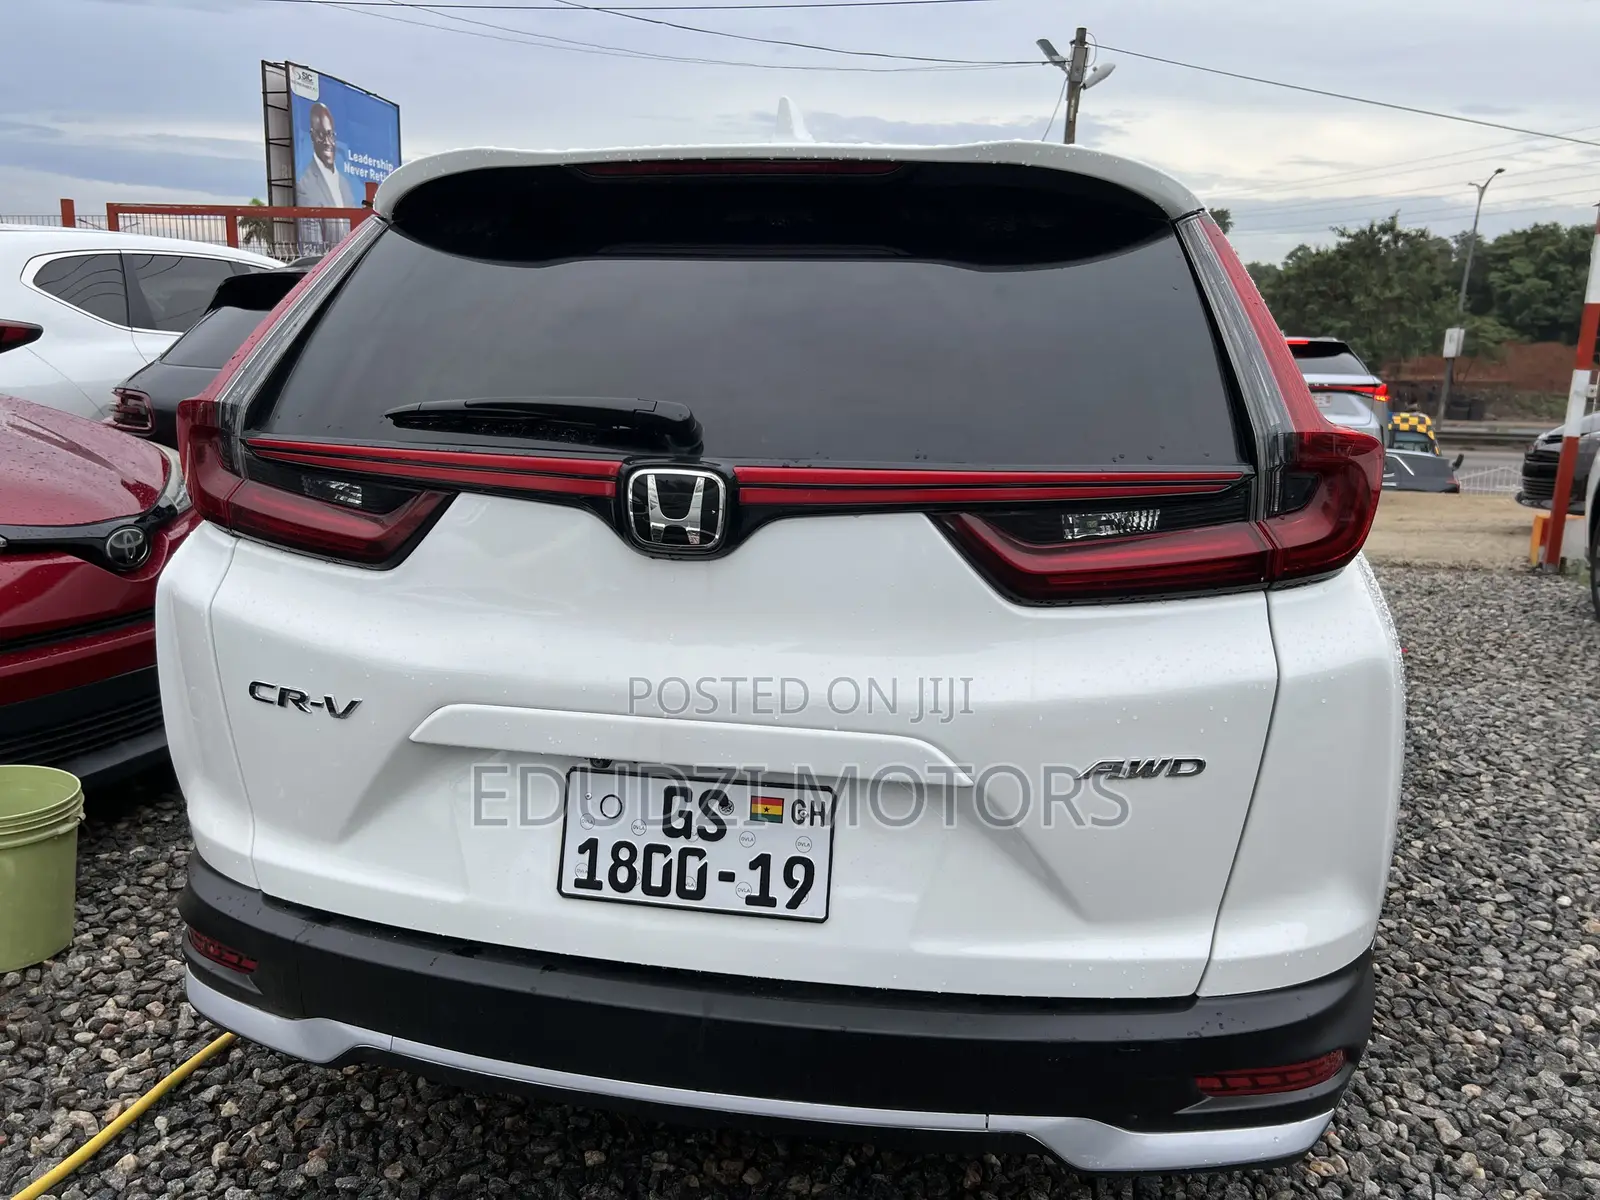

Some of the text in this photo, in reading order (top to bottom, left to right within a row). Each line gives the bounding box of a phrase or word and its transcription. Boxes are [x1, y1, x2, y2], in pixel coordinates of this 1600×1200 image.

[343, 161, 368, 178] Never
[348, 149, 394, 172] Leadership
[248, 680, 363, 719] CR-V
[1074, 756, 1207, 780] AWD
[661, 785, 730, 842] GS
[790, 798, 826, 828] GH
[574, 836, 816, 910] 1800-19
